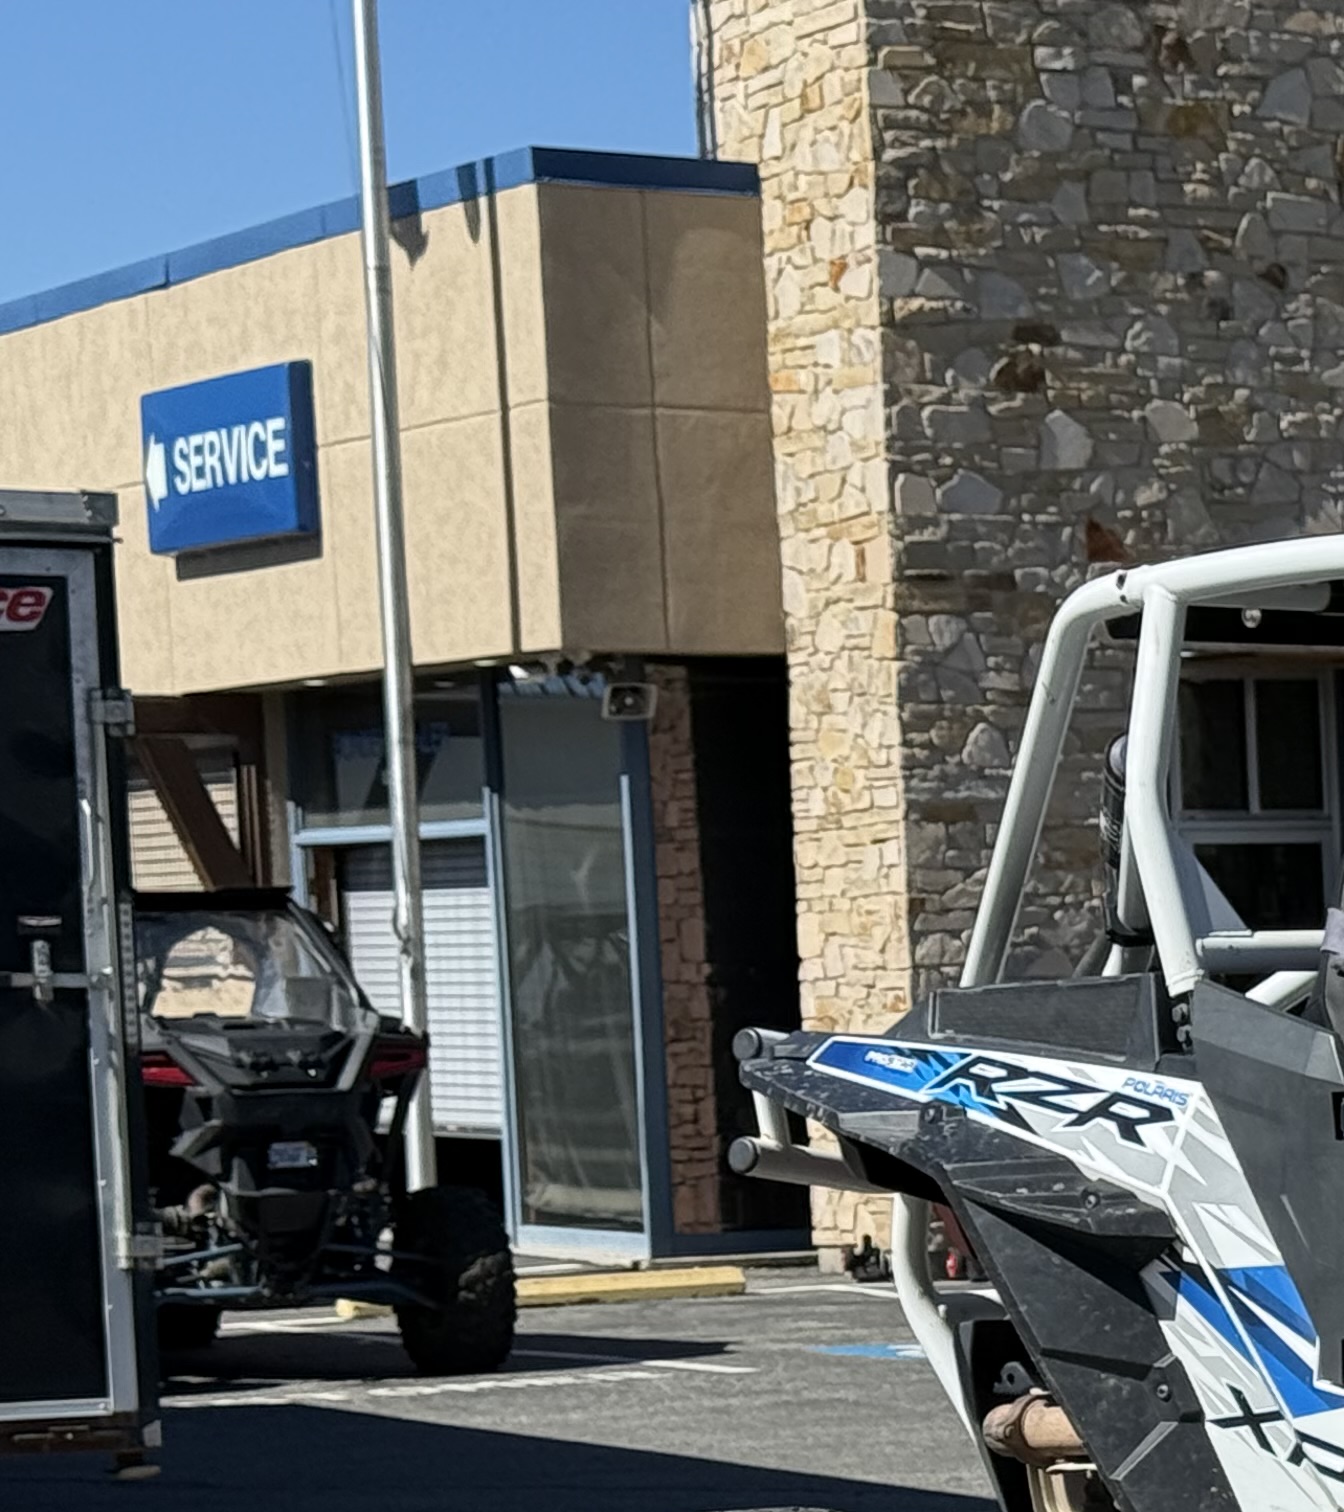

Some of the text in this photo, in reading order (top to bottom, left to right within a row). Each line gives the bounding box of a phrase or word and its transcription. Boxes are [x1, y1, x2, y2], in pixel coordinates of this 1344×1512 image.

[173, 416, 290, 496] SERVICE
[924, 1054, 1176, 1149] RZR
[1121, 1076, 1191, 1108] POLARIS
